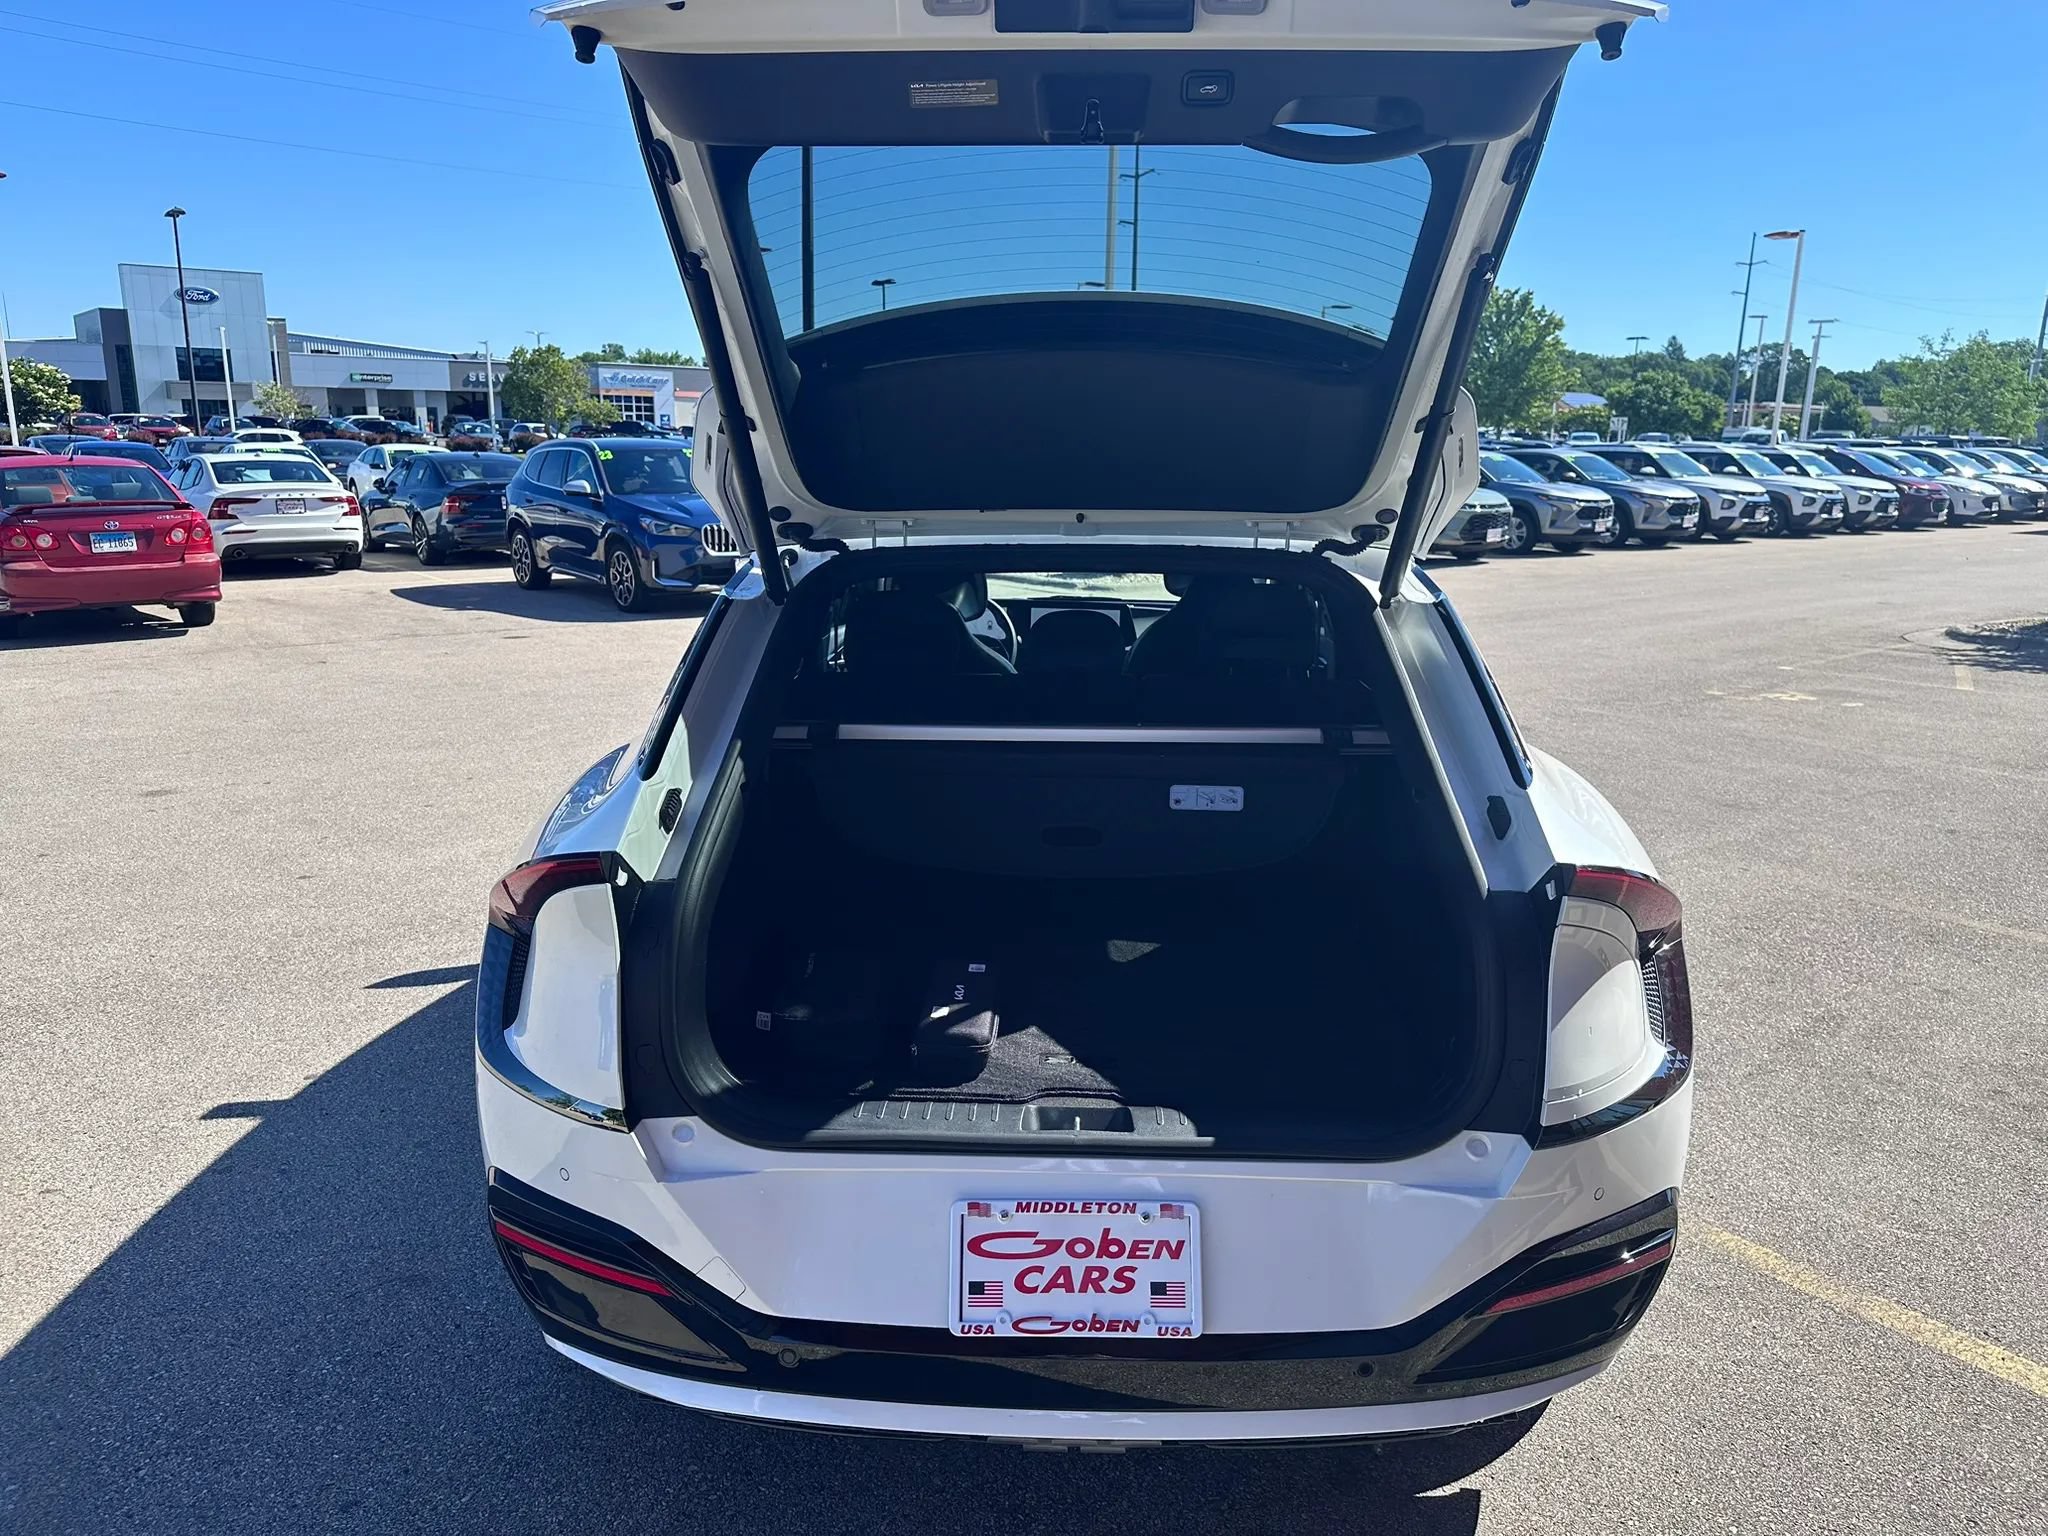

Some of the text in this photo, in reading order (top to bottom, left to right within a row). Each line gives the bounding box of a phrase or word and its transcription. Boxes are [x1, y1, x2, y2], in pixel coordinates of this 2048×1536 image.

[185, 290, 211, 301] Ford
[647, 376, 669, 385] Lane
[598, 449, 614, 460] 23
[92, 537, 134, 549] EC 11865
[1015, 1201, 1137, 1214] MIDDLETON
[1013, 1265, 1138, 1295] CARS
[960, 1324, 995, 1335] USA
[1157, 1326, 1193, 1337] USA
